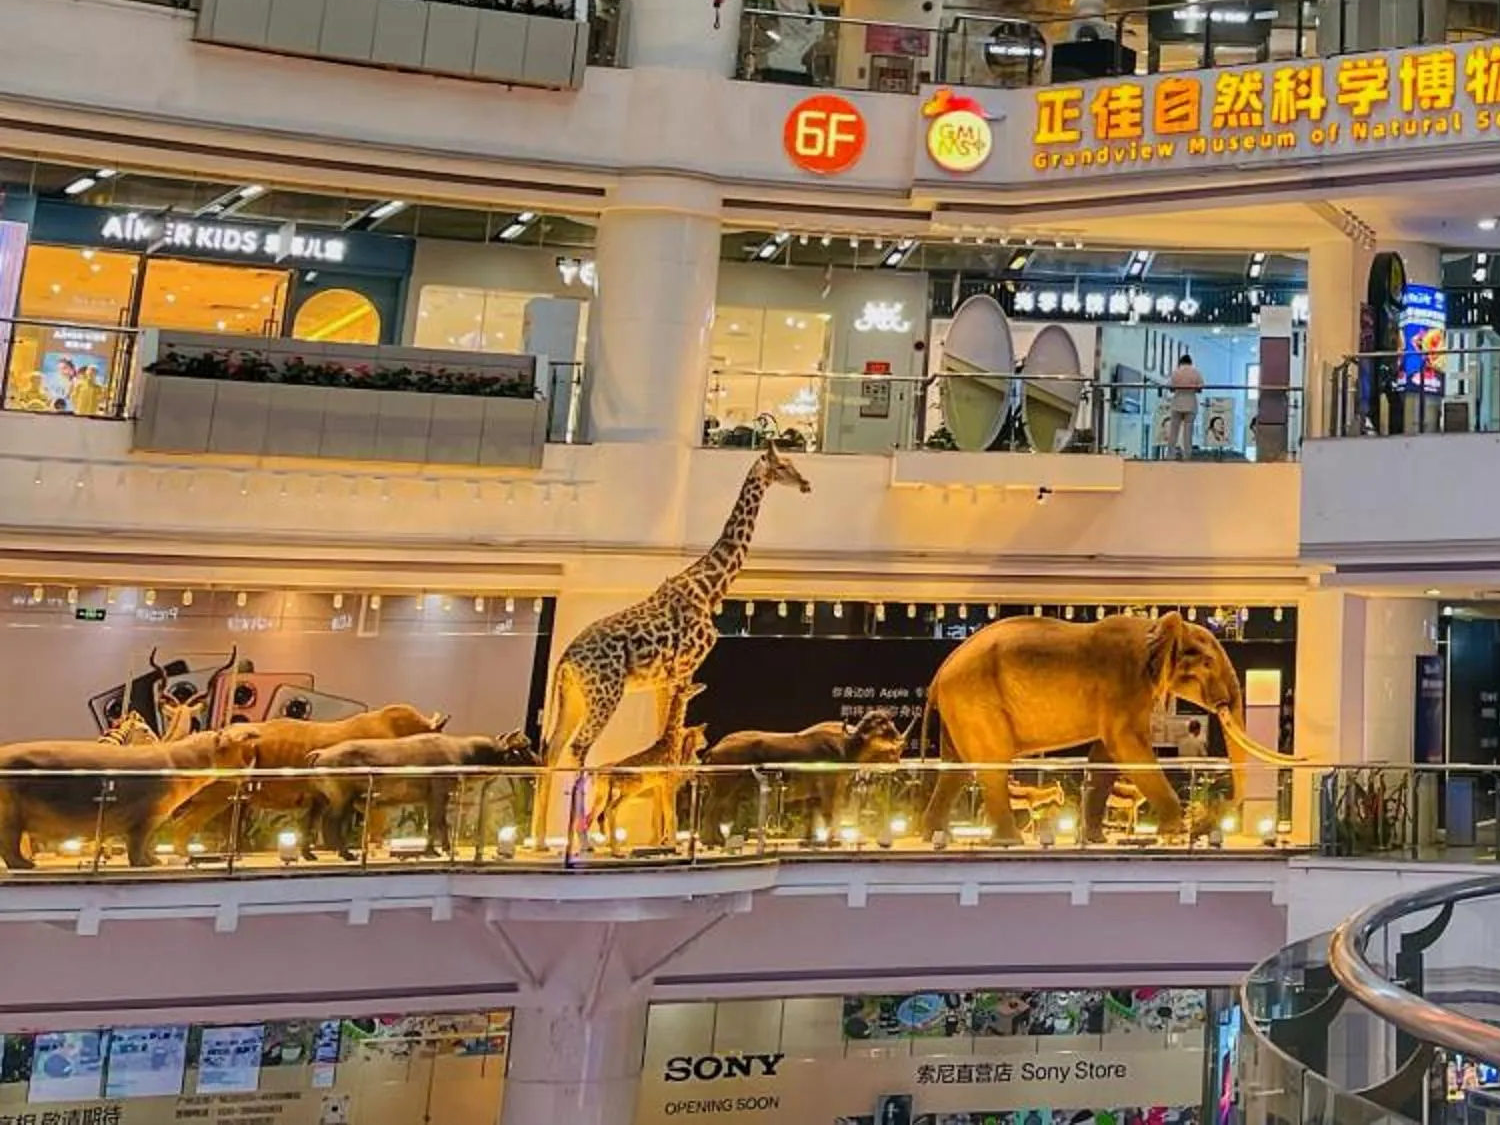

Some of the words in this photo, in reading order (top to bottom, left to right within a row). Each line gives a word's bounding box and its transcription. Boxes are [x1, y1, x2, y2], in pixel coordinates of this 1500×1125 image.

[794, 109, 857, 158] 6F
[1033, 141, 1175, 171] Grandview
[1187, 130, 1297, 156] Museum
[1310, 121, 1340, 145] of
[1352, 109, 1463, 142] Natural
[194, 226, 259, 254] KIDS
[880, 688, 909, 699] Apple
[664, 1053, 785, 1083] SONY
[916, 1062, 1012, 1085] 索尼直营店
[1020, 1063, 1072, 1084] Sony
[1075, 1060, 1127, 1081] Store
[664, 1097, 734, 1116] OPENING
[736, 1095, 781, 1113] SOON
